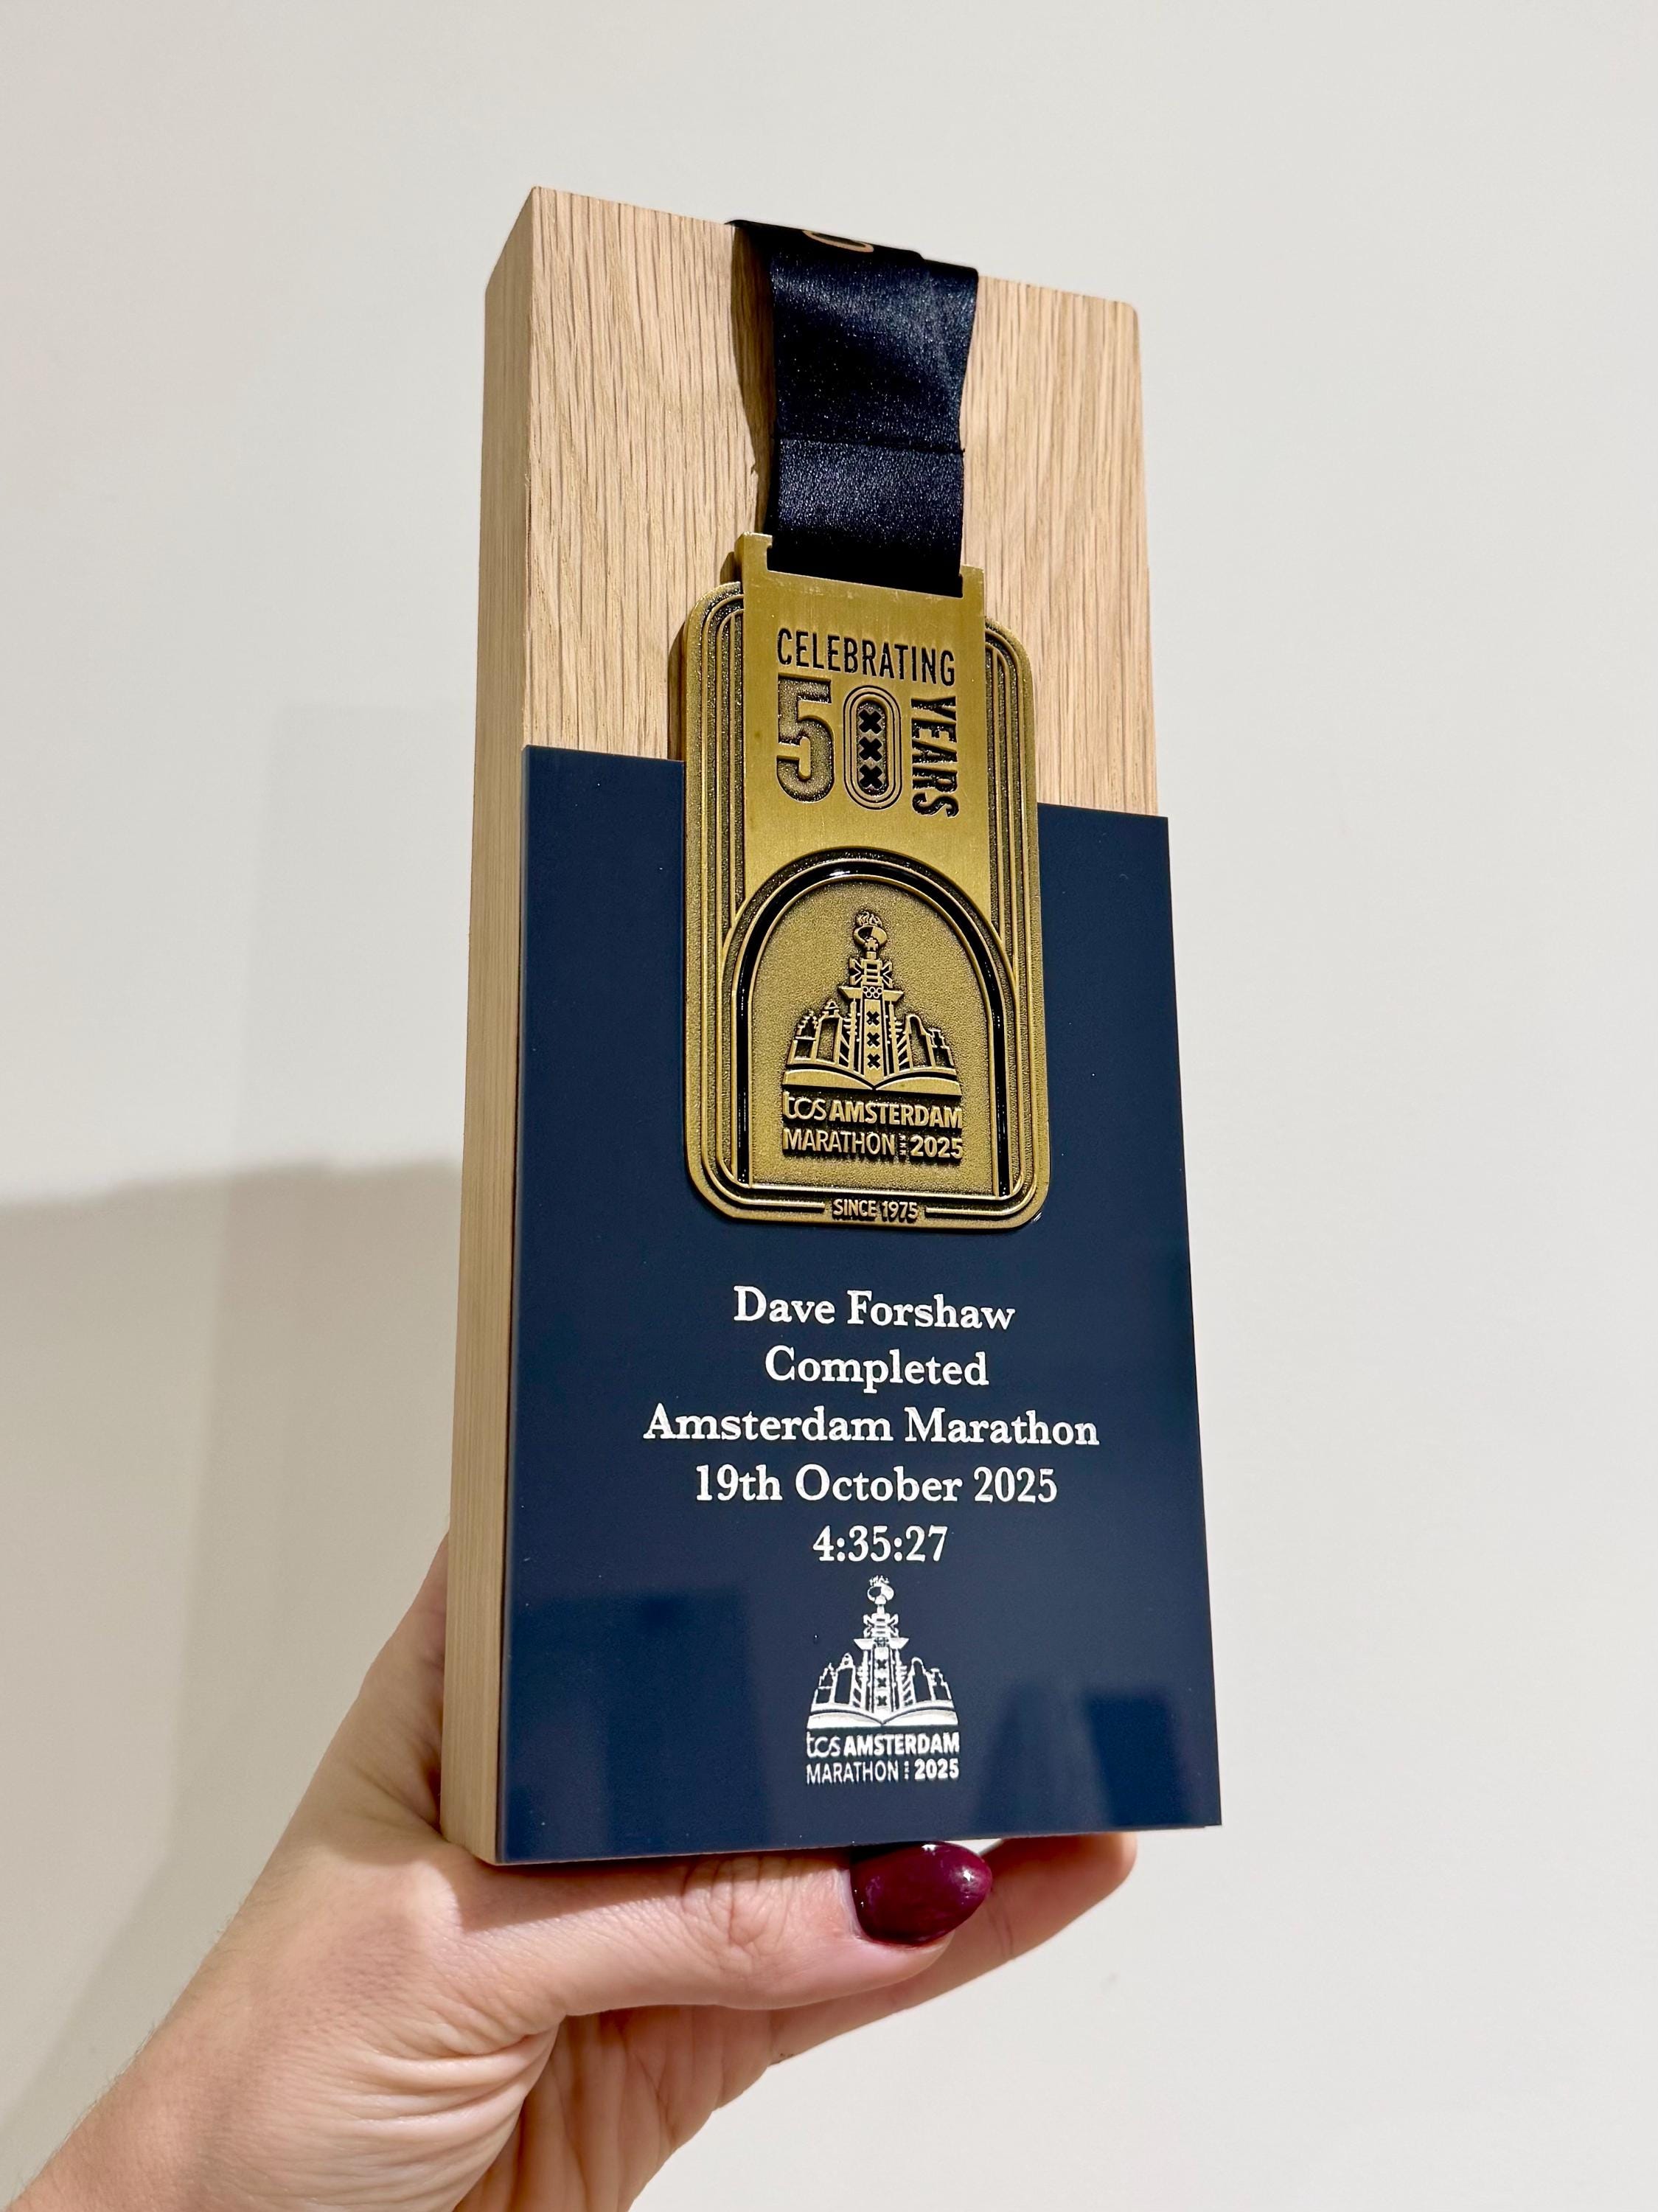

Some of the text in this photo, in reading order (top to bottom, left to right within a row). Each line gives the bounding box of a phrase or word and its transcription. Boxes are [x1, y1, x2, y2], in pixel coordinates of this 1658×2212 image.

[777, 627, 955, 686] CELEBRATING
[776, 672, 901, 810] 50
[911, 695, 960, 818] YEARS
[829, 1102, 962, 1129] AMSTERDAM
[783, 1128, 963, 1158] MARATHON 2025
[832, 1199, 919, 1219] SINCE 1975
[734, 1286, 1015, 1329] Dave Forshaw
[765, 1346, 989, 1394] Completed
[644, 1403, 1099, 1445] Amsterdam Marathon
[697, 1464, 1057, 1503] 19th October 2025
[813, 1525, 947, 1562] 4:35:27
[843, 1733, 959, 1756] AMSTERDAM
[806, 1759, 959, 1784] MARATHON 2025
